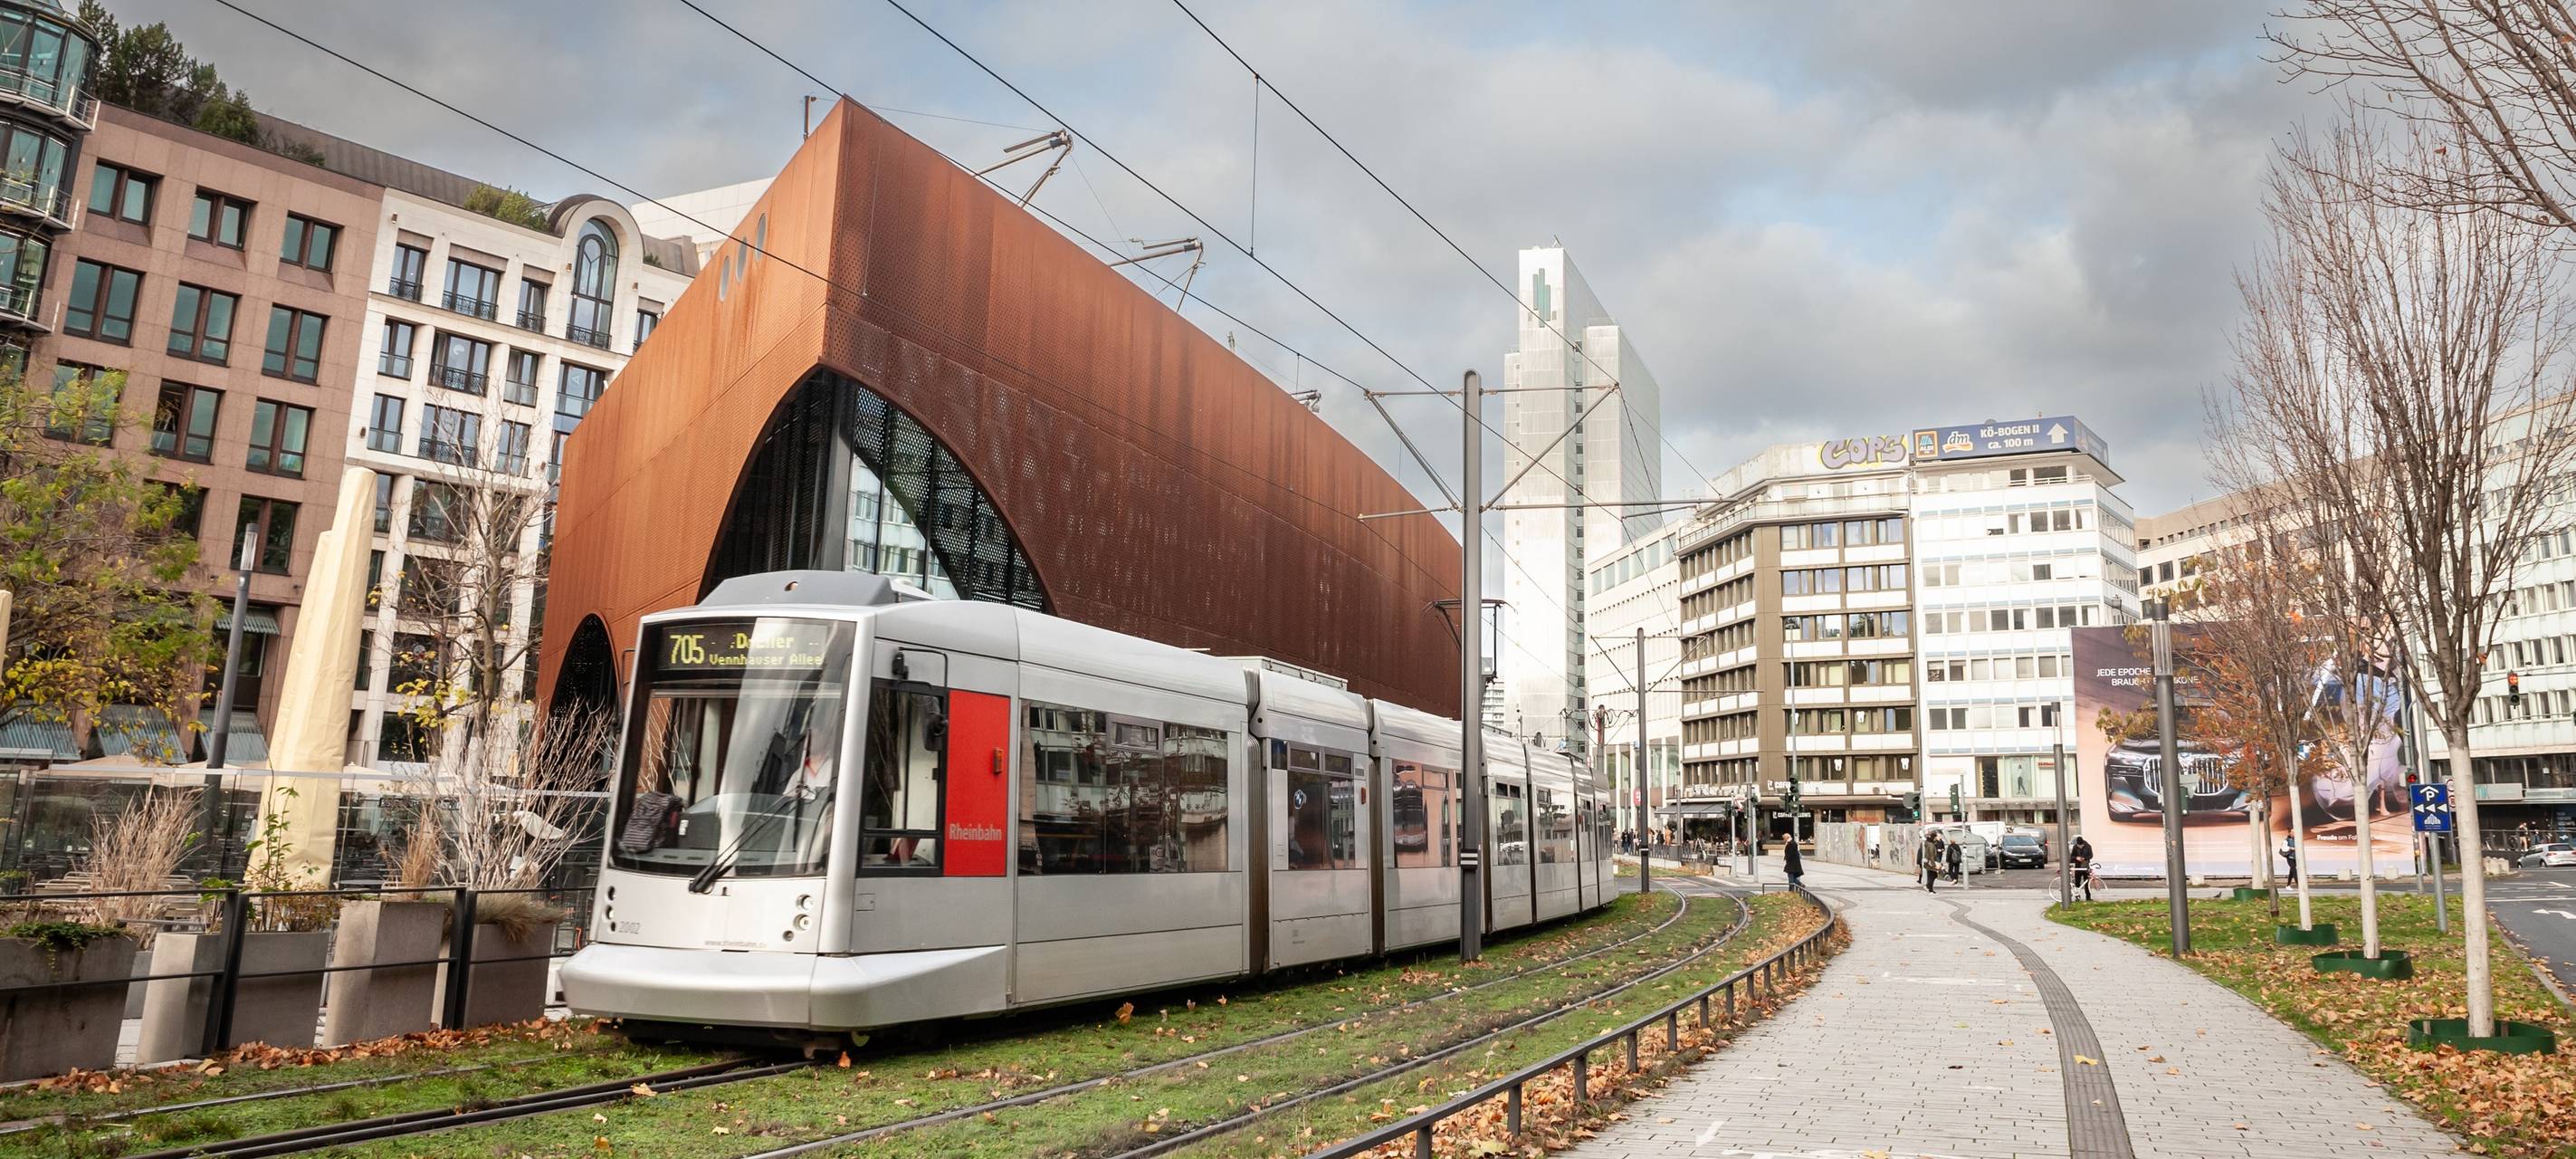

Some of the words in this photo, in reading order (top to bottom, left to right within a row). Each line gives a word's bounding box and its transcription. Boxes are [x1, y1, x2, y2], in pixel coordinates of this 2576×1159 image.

[1947, 431, 1970, 445] dm
[1980, 425, 2030, 438] KÖ-BOGEN
[2032, 425, 2040, 434] II
[1988, 441, 2002, 449] ca.
[2003, 437, 2021, 447] 100
[1820, 435, 1907, 470] COPS
[669, 635, 705, 665] 705
[788, 653, 825, 666] Allee
[2096, 668, 2116, 677] JEDE
[2117, 667, 2151, 676] EPOCHE
[2426, 790, 2435, 801] P
[949, 822, 1002, 841] Rheinbahn
